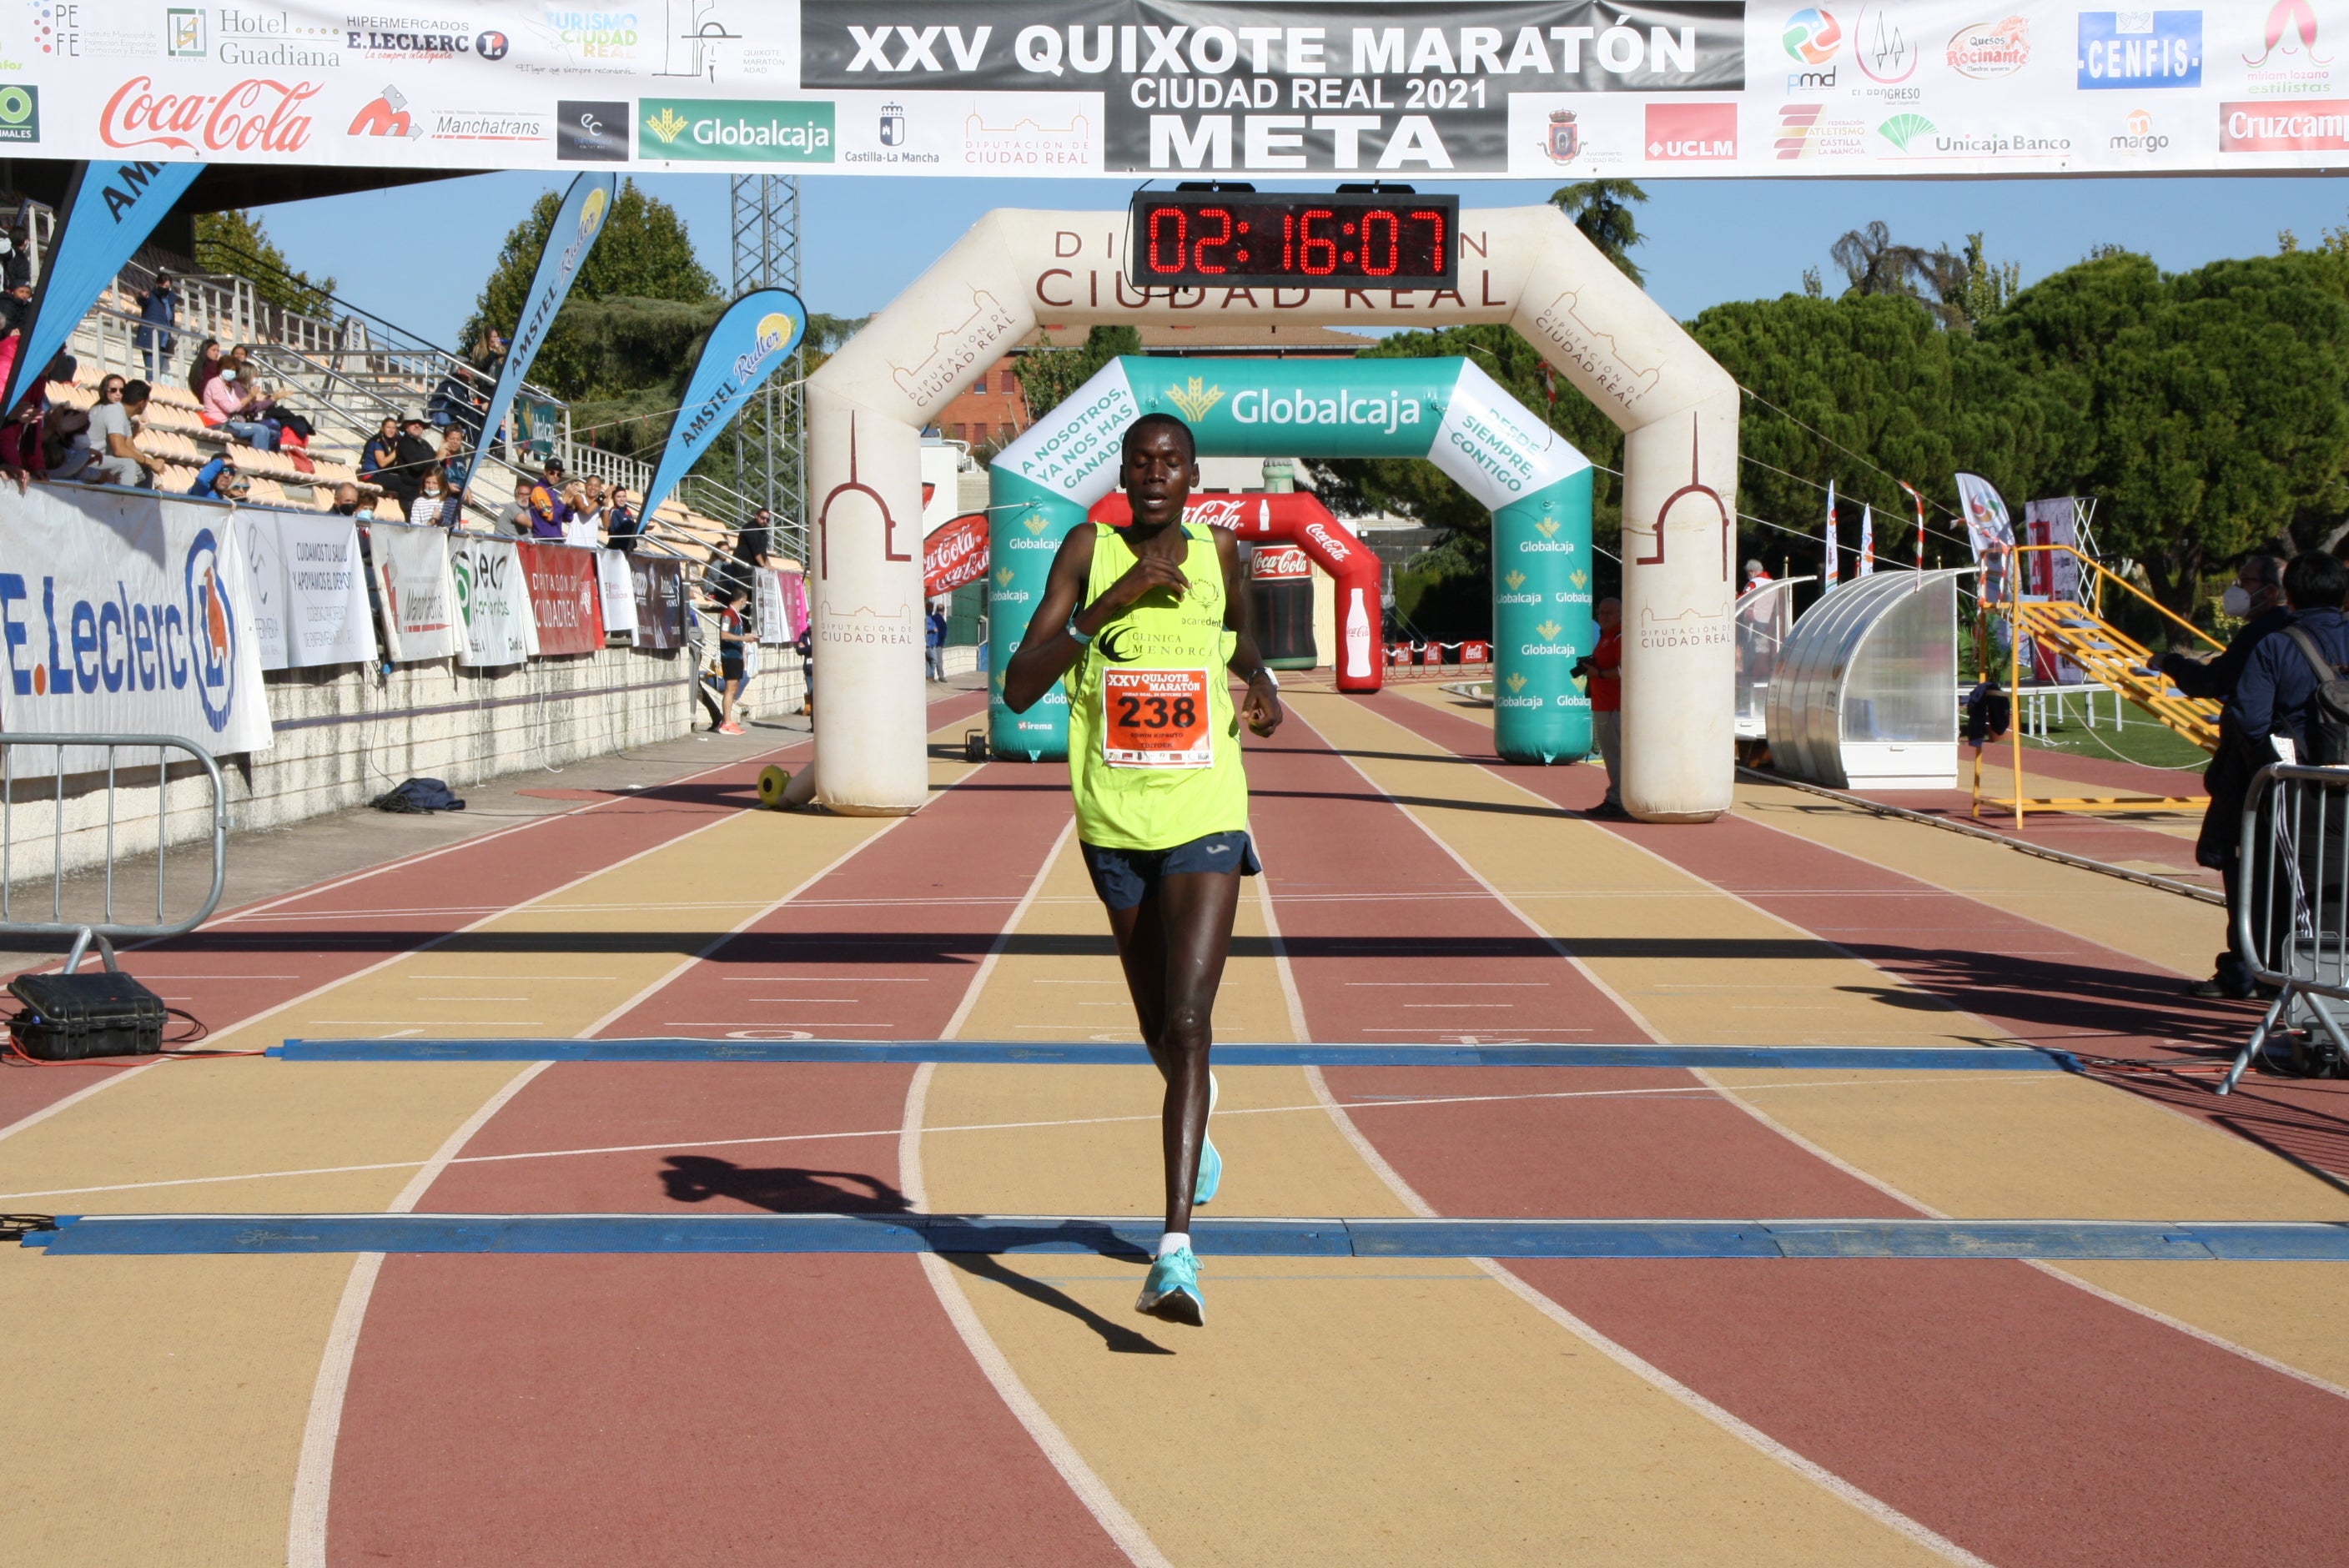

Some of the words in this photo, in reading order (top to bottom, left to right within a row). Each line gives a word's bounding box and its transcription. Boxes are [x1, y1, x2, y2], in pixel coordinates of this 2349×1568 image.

[56, 4, 79, 28] PE
[220, 9, 289, 33] Hotel
[347, 16, 469, 31] HIPERMERCADOS
[546, 12, 638, 30] TURISMO
[57, 33, 80, 57] FE
[347, 32, 469, 53] E.LECLERC
[561, 29, 638, 46] CIUDAD
[845, 26, 993, 72] XXV
[1014, 25, 1326, 77] QUIXOTE
[1351, 15, 1696, 74] MARATÓN
[1969, 37, 2005, 47] Quesos
[219, 43, 340, 68] Guadiana
[365, 48, 375, 59] La
[378, 50, 406, 63] compra
[409, 48, 453, 64] inteligente
[583, 43, 636, 58] REAL
[1945, 48, 2028, 68] Rocinante
[564, 65, 591, 75] siempre
[743, 58, 786, 66] MARATÓN
[1787, 65, 1837, 95] pmd
[2247, 71, 2287, 81] miriam
[2291, 70, 2330, 79] lozano
[1131, 78, 1279, 109] CIUDAD
[1292, 78, 1394, 109] REAL
[1406, 78, 1486, 109] 2021
[2248, 81, 2331, 94] estilistas
[99, 76, 325, 153] Coca-Cola
[436, 115, 541, 137] Manchatrans
[1808, 127, 1865, 136] ATLETISMO
[693, 119, 829, 154] Globalcaja
[965, 140, 1063, 149] DIPUTACIÓN
[1072, 141, 1089, 149] DE
[1149, 114, 1454, 169] META
[1820, 138, 1862, 147] CASTILLA
[1935, 133, 2009, 155] Unicaja
[2013, 135, 2070, 151] Banco
[2110, 135, 2169, 153] margo
[845, 151, 898, 163] Castilla-La
[902, 152, 940, 163] Mancha
[965, 151, 1039, 164] CIUDAD
[1045, 152, 1089, 164] REAL
[1667, 140, 1733, 157] UCLM
[101, 161, 168, 225] AM
[1149, 208, 1443, 276] 02:16:07
[990, 307, 1008, 323] DE
[511, 284, 558, 378] AMSTEL
[734, 329, 781, 386] Radler
[916, 351, 976, 407] CIUDAD
[977, 316, 1016, 350] REAL
[1536, 316, 1594, 373] CIUDAD
[1597, 374, 1636, 410] REAL
[1544, 309, 1622, 382] DIPUTACIÓN
[1627, 385, 1643, 401] DE
[681, 380, 737, 449] AMSTEL
[1231, 389, 1421, 434] Globalcaja
[1021, 460, 1035, 475] A
[1034, 388, 1127, 461] NOSOTROS,
[1036, 462, 1064, 484] YA
[1061, 432, 1098, 465] NOS
[1096, 404, 1134, 437] HAS
[1461, 415, 1534, 481] SIEMPRE,
[1450, 431, 1522, 492] CONTIGO
[296, 541, 324, 562] CUIDAMOS
[324, 543, 332, 562] TU
[1305, 522, 1352, 561] Coca-Cola
[1519, 540, 1575, 555] Globalcaja
[1253, 549, 1308, 575] Coca-Cola
[297, 571, 326, 591] APOYAMOS
[326, 571, 333, 591] EL
[1496, 592, 1542, 606] Globalcaja
[0, 572, 188, 696] E.Leclerc
[821, 622, 895, 633] DIPUTACIÓN
[1132, 631, 1182, 643] CLINICA
[1641, 625, 1718, 636] DIPUTACIÓN
[821, 631, 876, 644] CIUDAD
[881, 633, 913, 645] REAL
[1641, 636, 1700, 648] CIUDAD
[1705, 634, 1731, 645] REAL
[1521, 643, 1576, 658] Globalcaja
[1108, 674, 1141, 687] XXV
[1141, 673, 1190, 684] QUIJOTE
[1149, 681, 1200, 691] MARATÓN
[1118, 696, 1196, 729] 238
[1497, 695, 1543, 710] Globalcaja
[1027, 722, 1053, 731] irema
